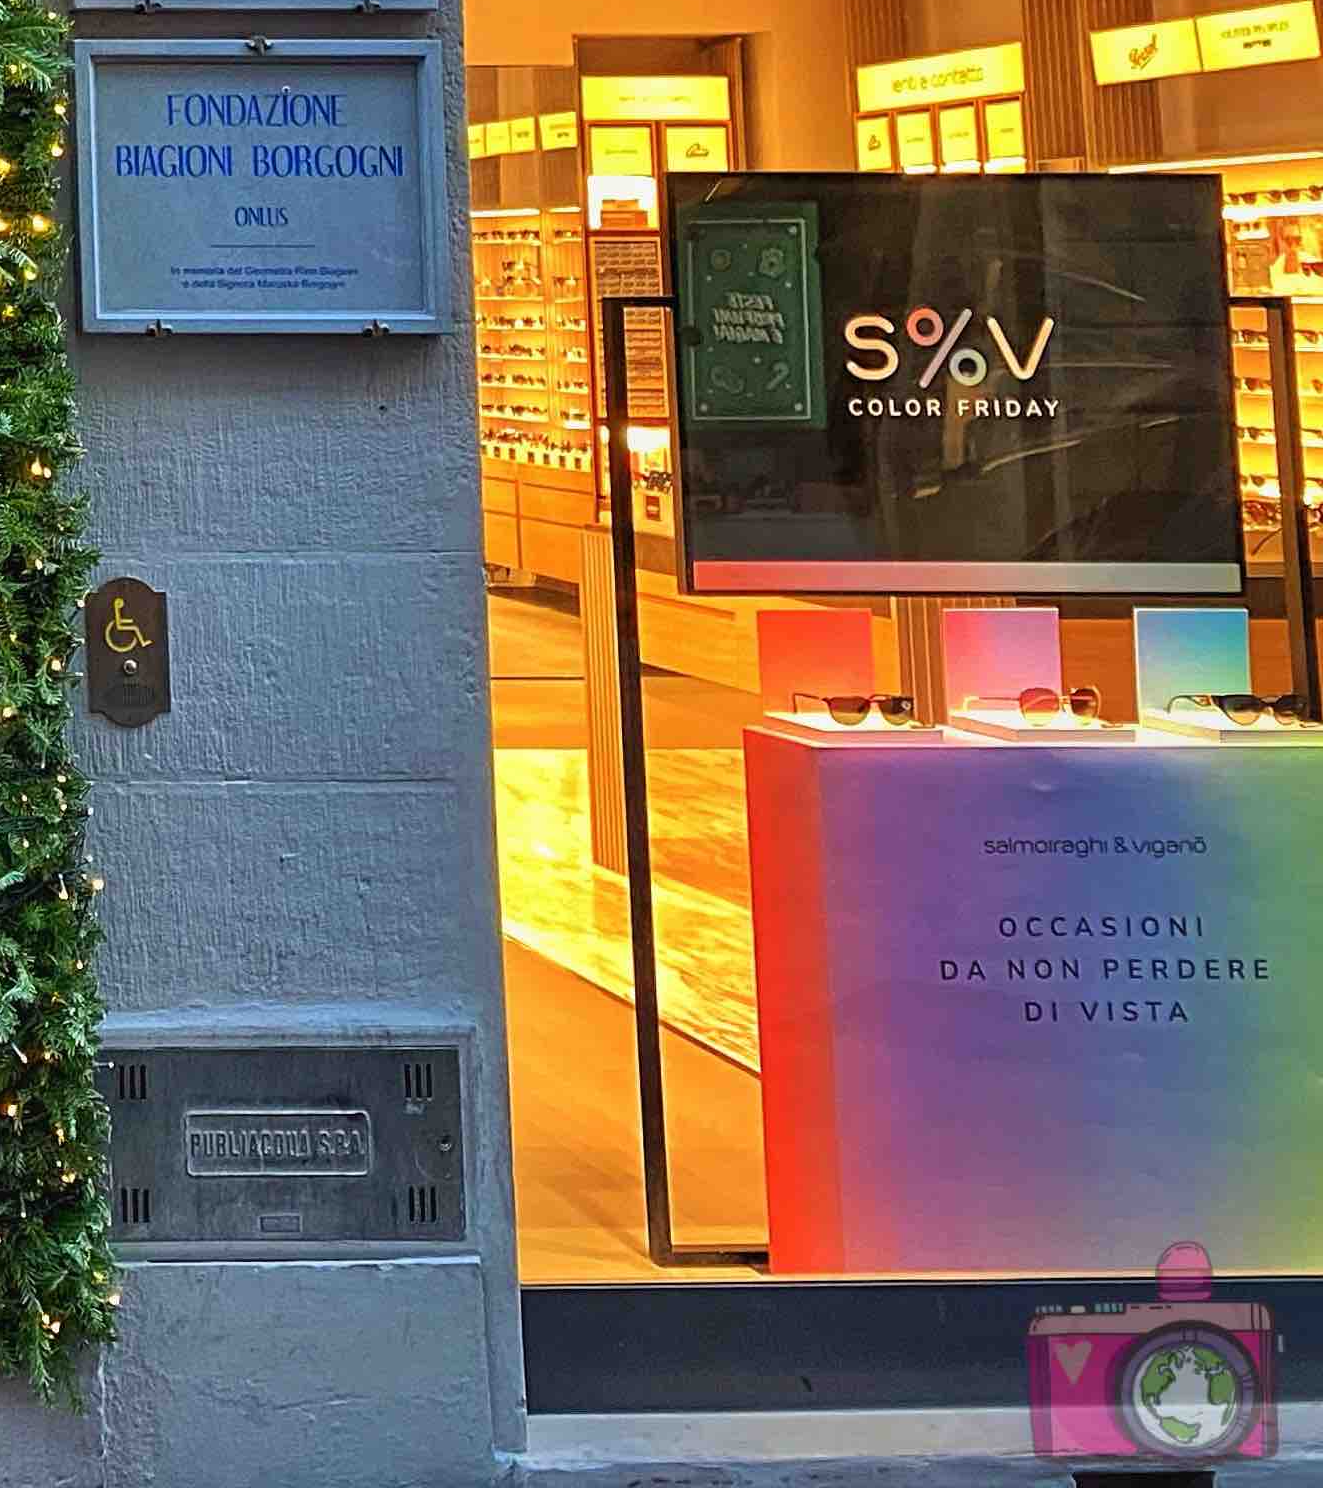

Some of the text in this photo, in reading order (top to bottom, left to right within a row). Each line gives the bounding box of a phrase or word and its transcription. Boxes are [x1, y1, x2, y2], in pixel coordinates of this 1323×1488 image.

[167, 94, 348, 127] FONDAZIONE
[116, 145, 404, 178] BIAGIONI BORGOGNI
[234, 207, 288, 227] ONLUS
[848, 398, 1060, 418] COLOR FRIDAY
[983, 835, 1108, 858] salmoiraghi
[1113, 836, 1129, 854] &
[998, 916, 1203, 938] OCCASIONI
[939, 959, 1270, 981] DA NON PERDERE
[1024, 1001, 1189, 1023] DI VISTA
